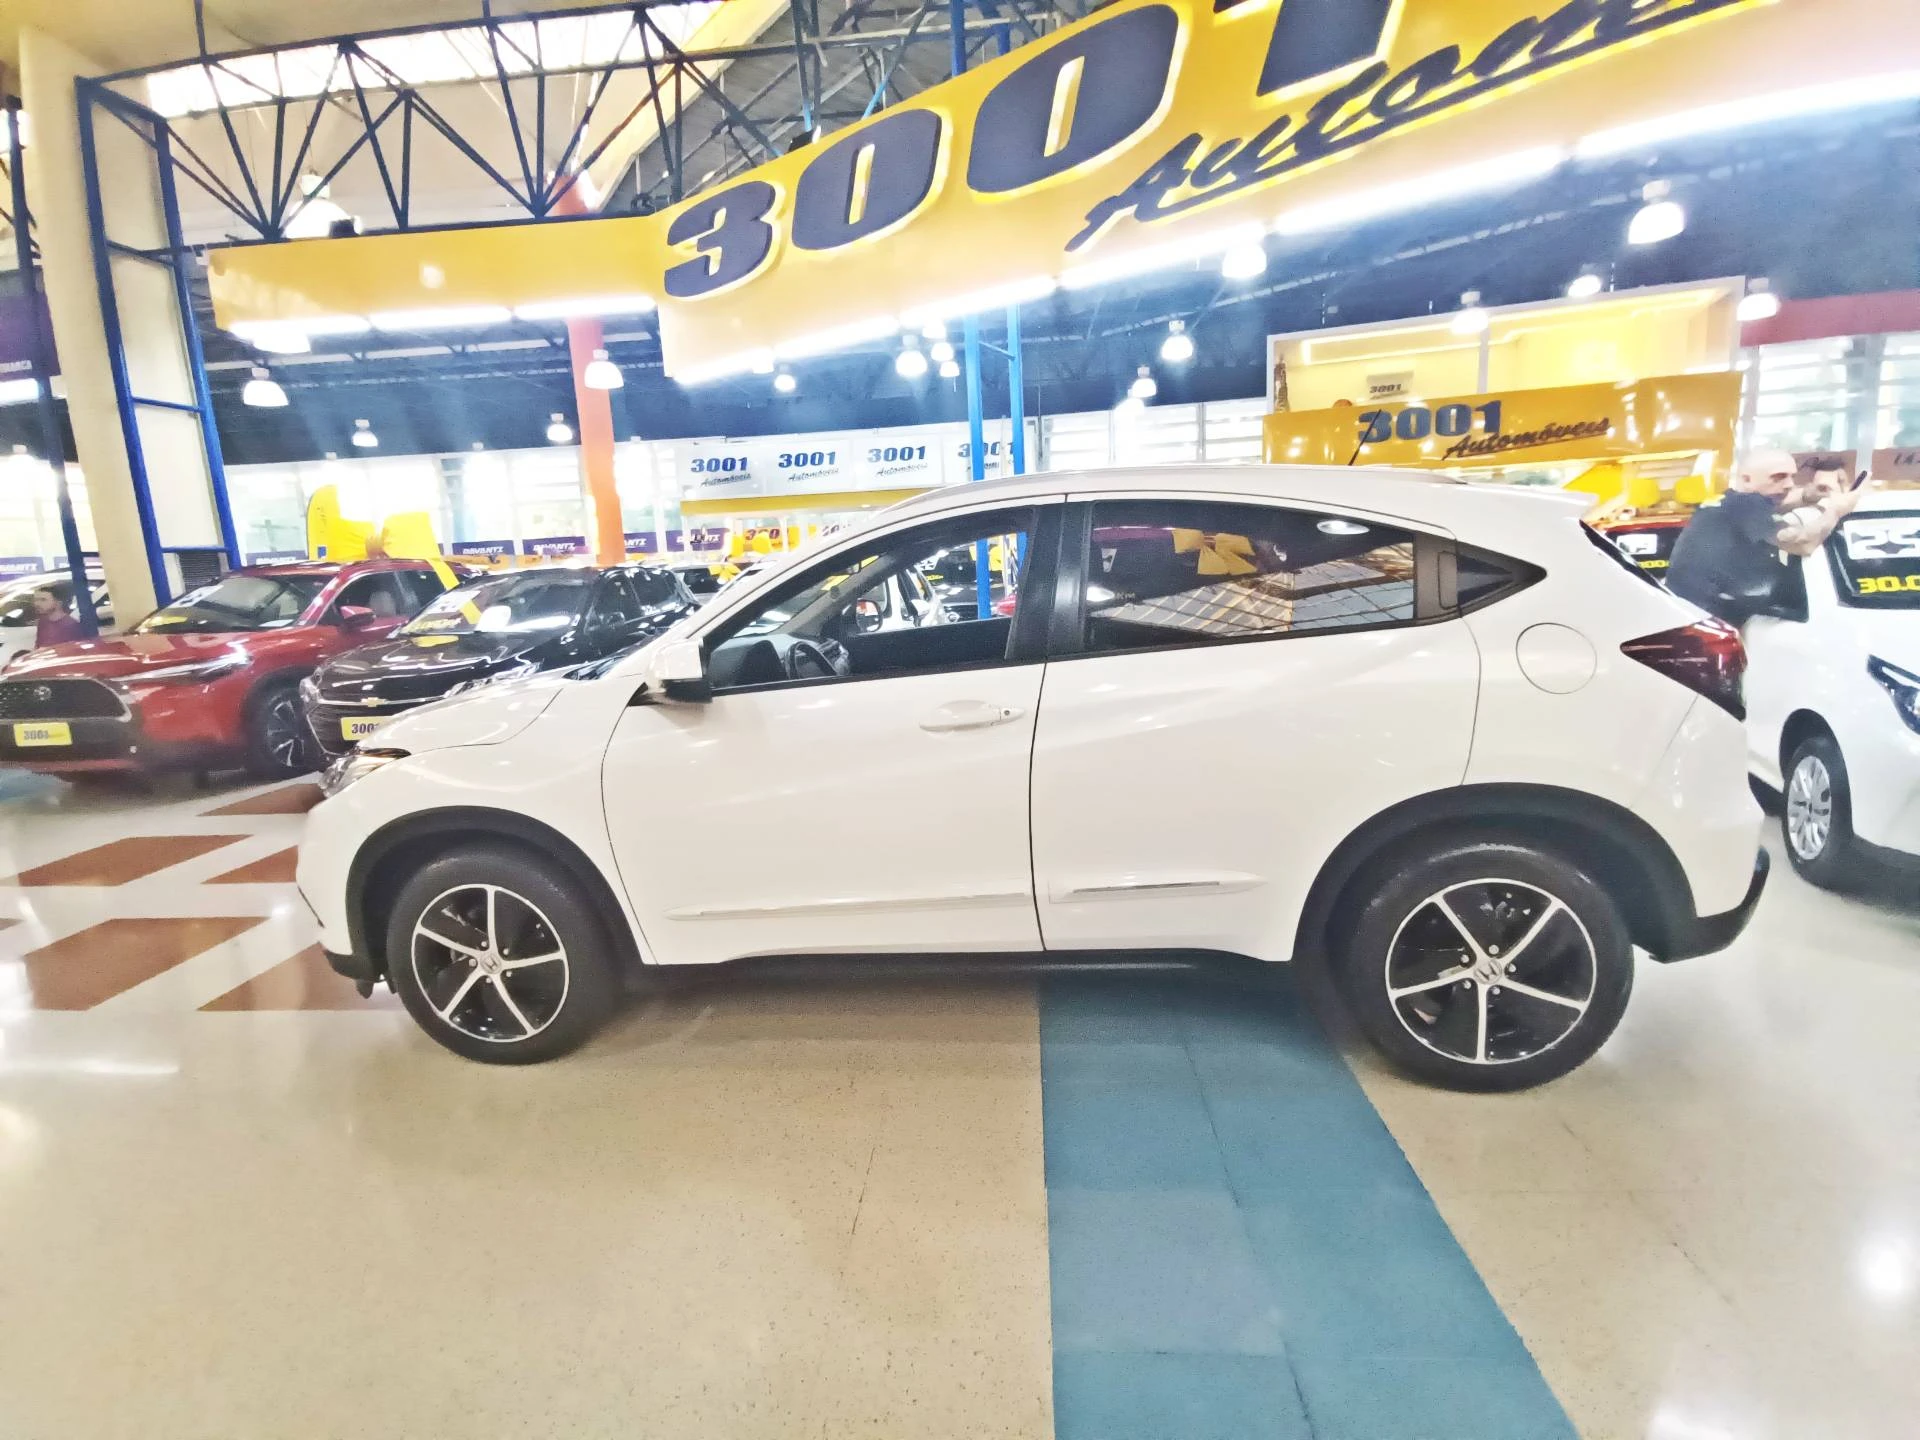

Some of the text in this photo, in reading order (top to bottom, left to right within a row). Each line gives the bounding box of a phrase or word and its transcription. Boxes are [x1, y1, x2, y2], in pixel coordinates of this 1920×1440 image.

[1357, 400, 1502, 443] 3001
[778, 451, 836, 468] 3001
[868, 446, 926, 463] 3001
[691, 457, 748, 472] 3001
[352, 723, 379, 734] 300
